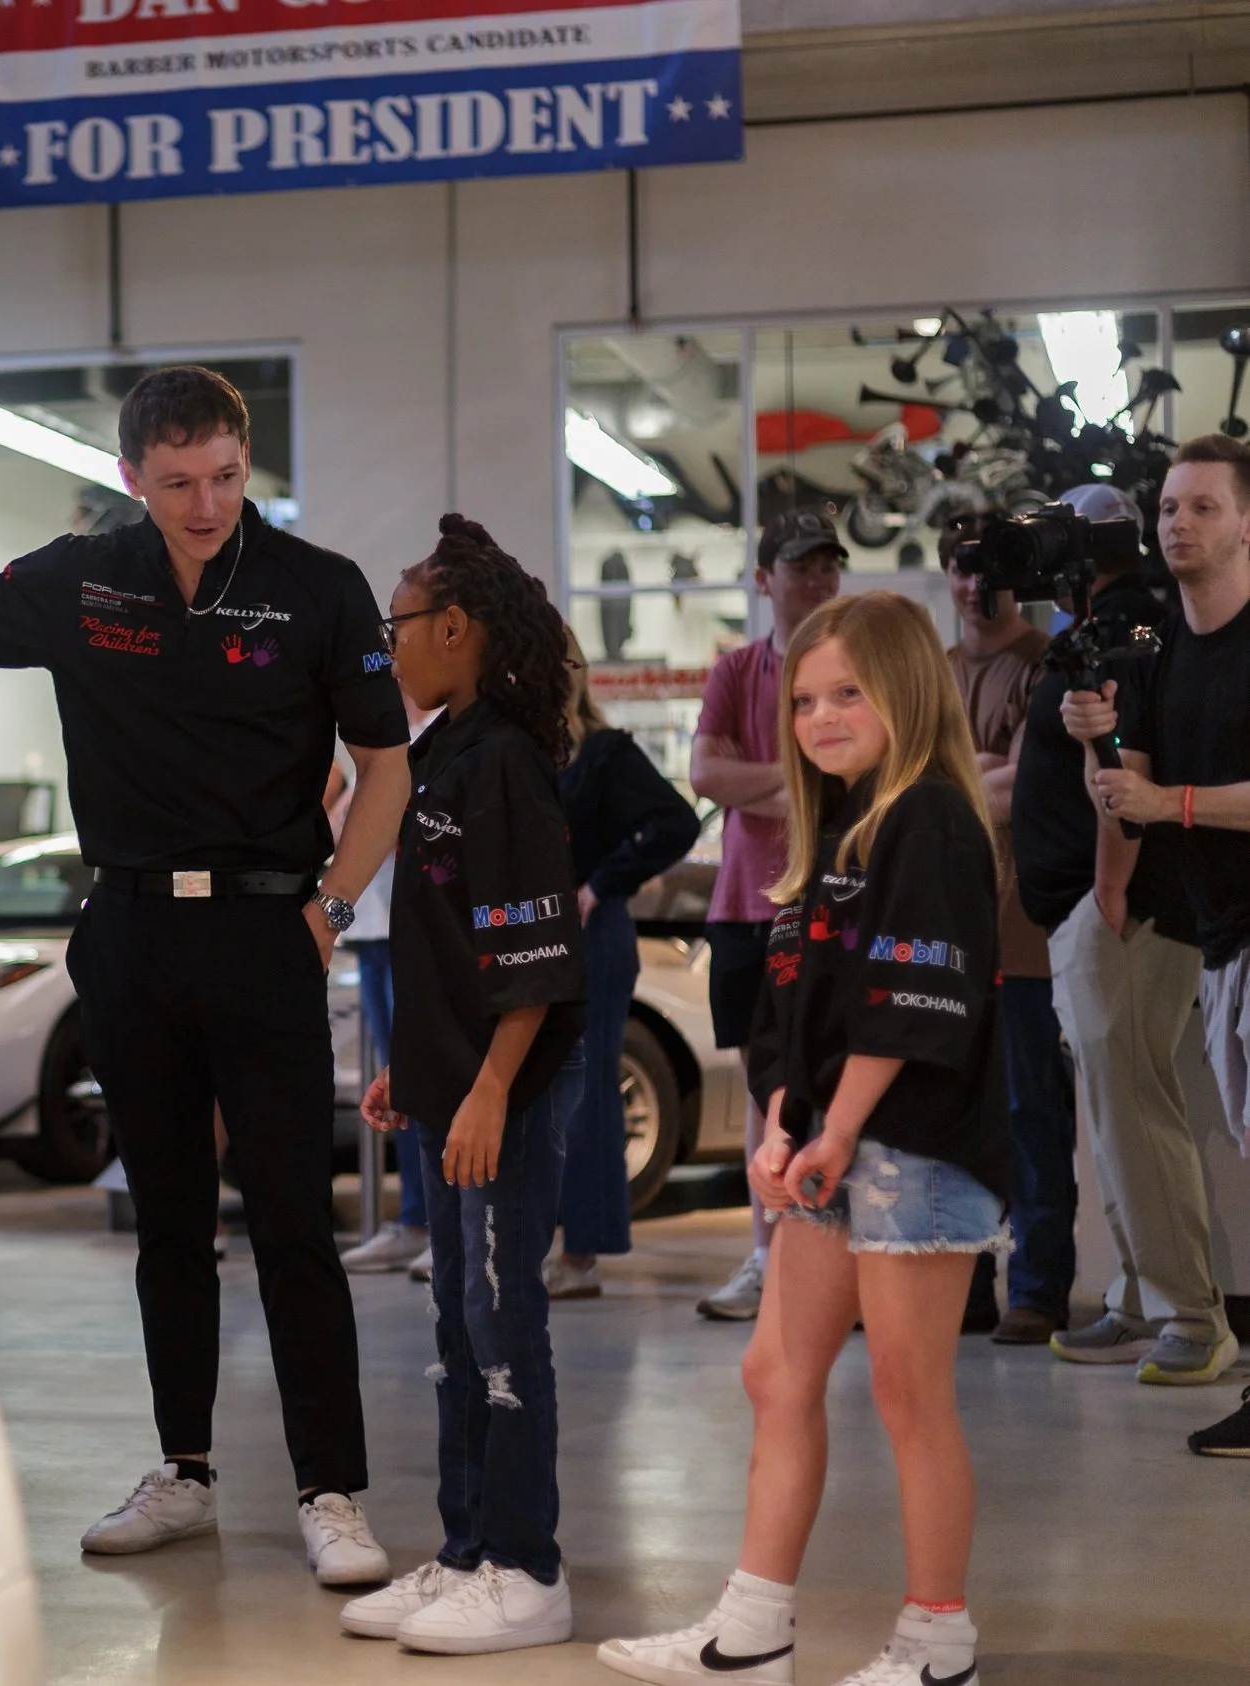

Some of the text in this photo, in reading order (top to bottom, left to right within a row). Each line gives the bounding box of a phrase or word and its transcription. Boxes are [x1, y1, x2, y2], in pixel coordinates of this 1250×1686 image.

[85, 24, 590, 80] BARBER MOTORSPORTS CANDIDATE
[22, 79, 659, 186] FOR PRESIDENT
[81, 580, 156, 602] PORSCHE
[79, 615, 160, 644] Racing for
[473, 901, 535, 929] Mobil
[496, 944, 569, 966] YOKOHAMA
[869, 936, 948, 966] Mobil
[892, 992, 967, 1017] YOKOHAMA
